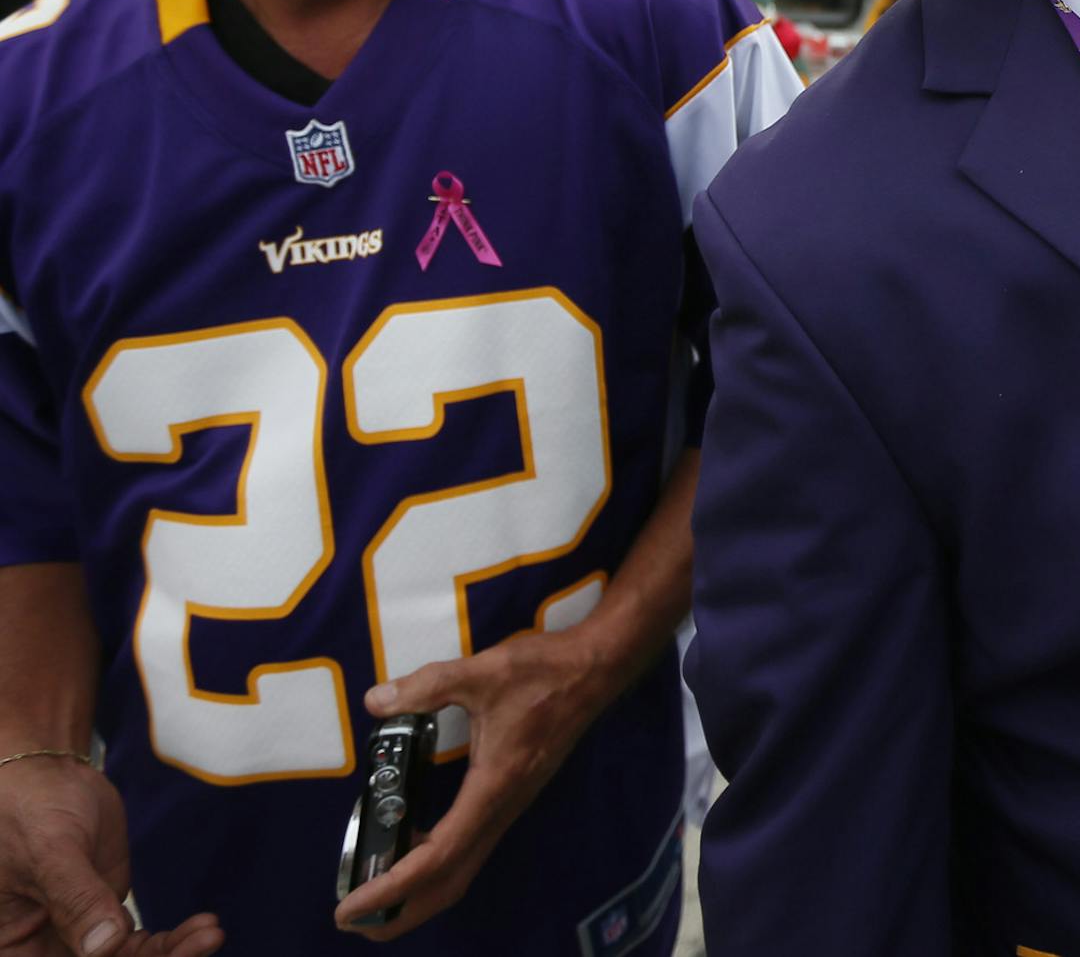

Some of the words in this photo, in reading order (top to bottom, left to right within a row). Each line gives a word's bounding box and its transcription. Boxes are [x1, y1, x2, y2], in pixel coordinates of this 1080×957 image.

[300, 148, 346, 177] NFL
[258, 225, 385, 274] VIKINGS
[83, 286, 612, 785] 22
